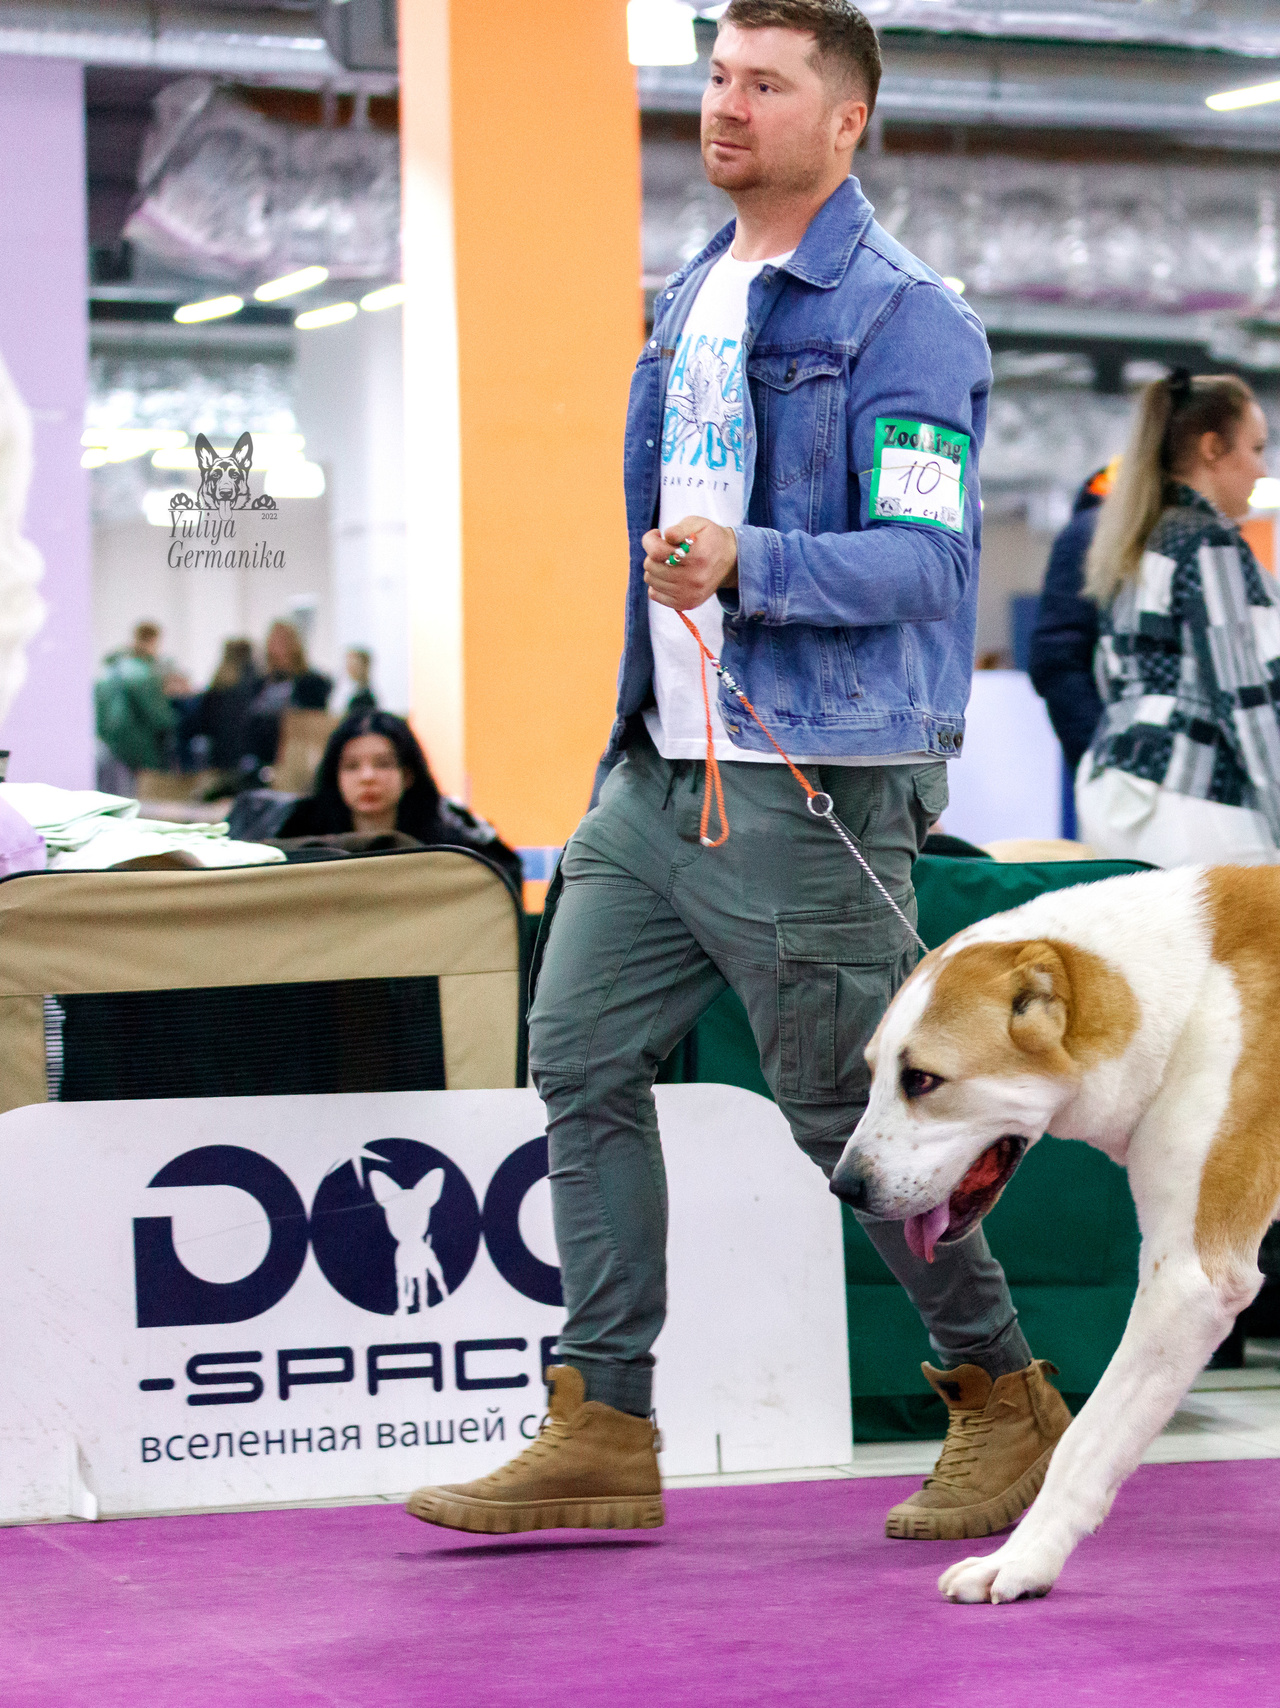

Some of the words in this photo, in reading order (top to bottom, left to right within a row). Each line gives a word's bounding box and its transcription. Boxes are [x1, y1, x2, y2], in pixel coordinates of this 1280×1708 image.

[898, 460, 941, 495] 10
[141, 1424, 361, 1463] вселенная
[377, 1406, 506, 1449] вашей
